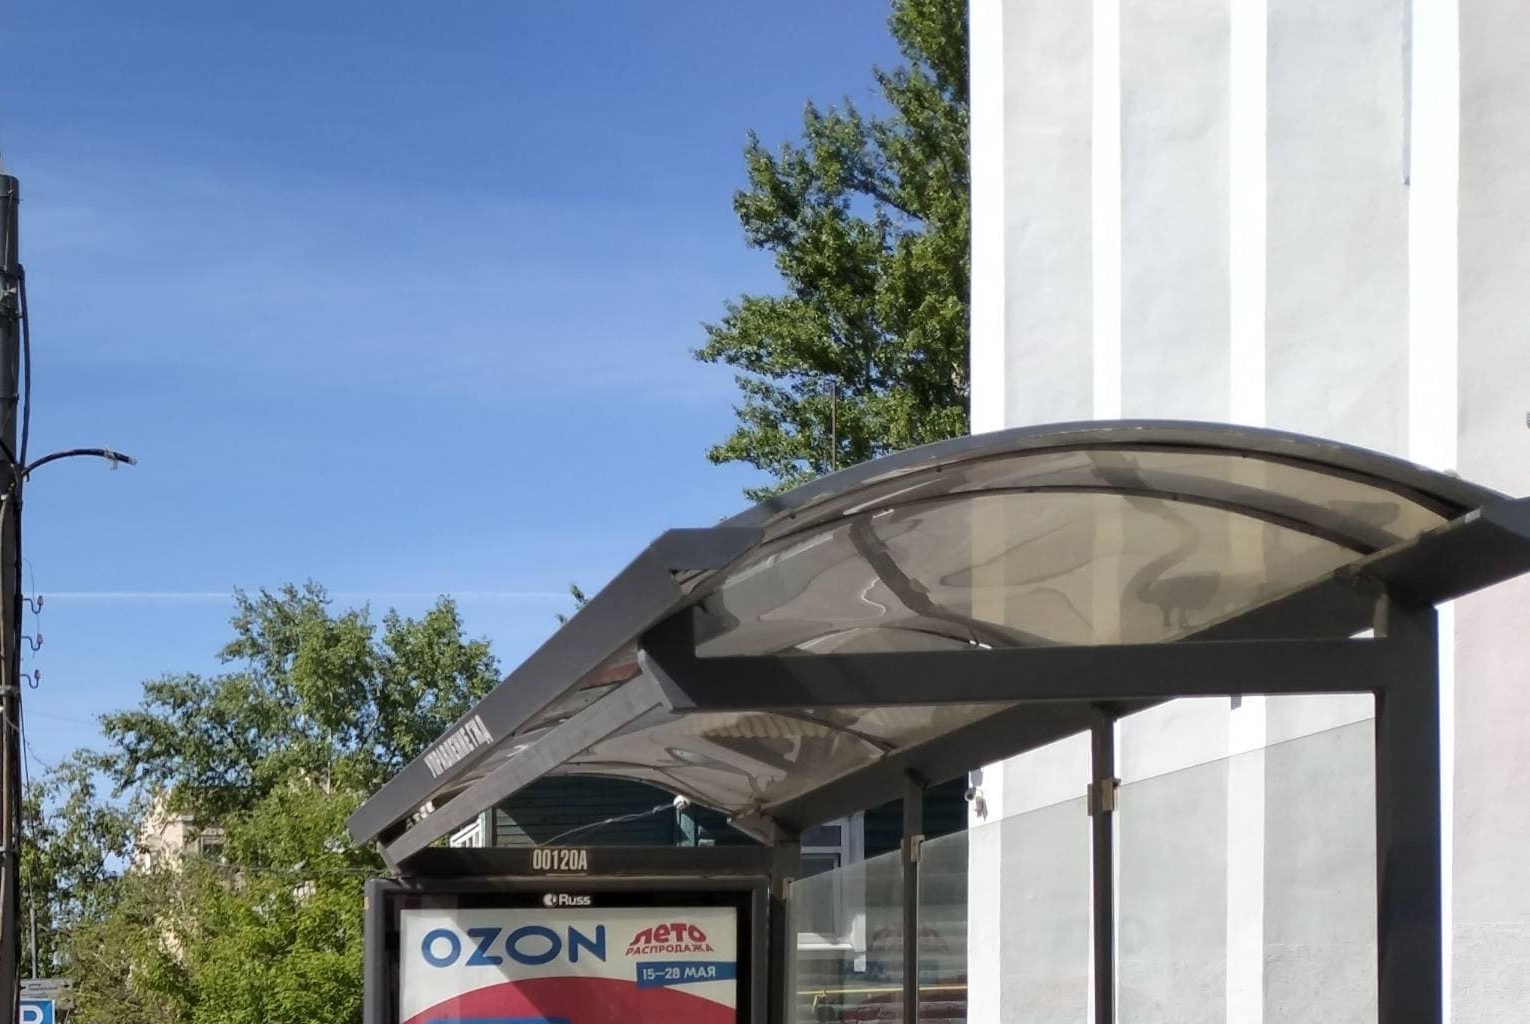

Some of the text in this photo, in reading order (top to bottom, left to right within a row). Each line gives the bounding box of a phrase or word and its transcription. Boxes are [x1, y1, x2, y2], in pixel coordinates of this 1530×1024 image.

[532, 850, 588, 870] 00120A
[558, 893, 591, 906] Russ
[421, 924, 607, 968] OZON
[625, 943, 715, 956] РАСПРОДАЖА
[683, 966, 716, 979] МАЯ
